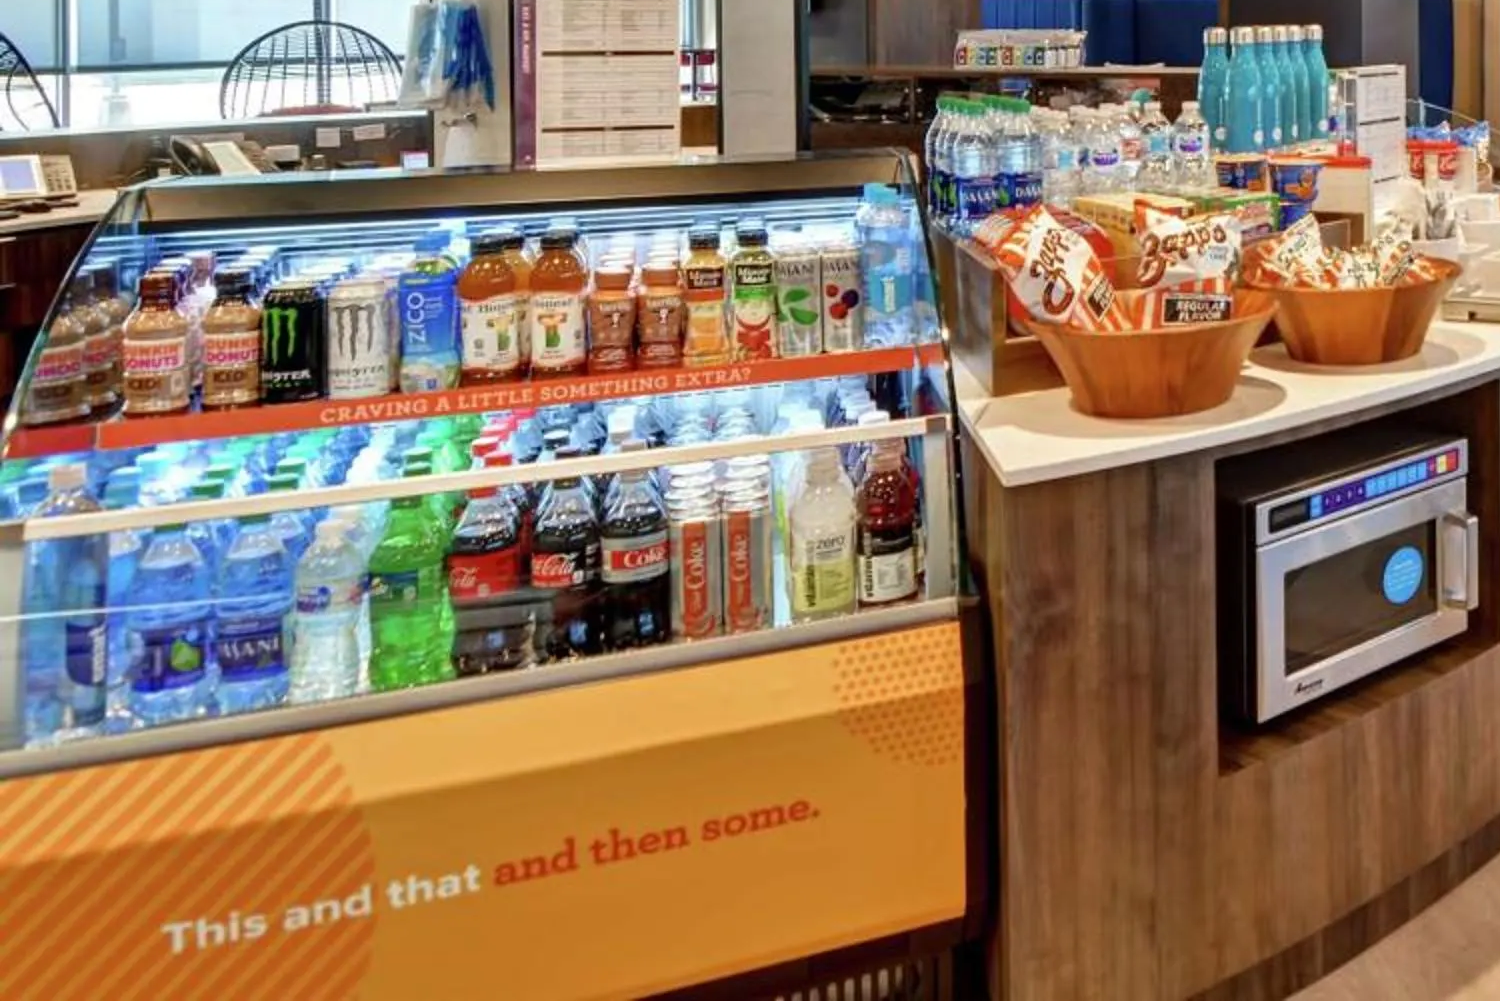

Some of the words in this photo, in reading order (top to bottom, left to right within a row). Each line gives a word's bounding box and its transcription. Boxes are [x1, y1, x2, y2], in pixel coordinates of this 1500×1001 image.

[407, 292, 427, 344] ZICO
[1176, 300, 1226, 312] REGULAR
[320, 400, 428, 424] CRAVING
[434, 396, 452, 412] A
[457, 387, 534, 410] LITTLE
[540, 376, 669, 401] SOMETHING
[675, 367, 753, 388] EXTRA?
[624, 548, 667, 568] Coke
[686, 540, 706, 590] Coke
[731, 534, 749, 582] Coke
[816, 535, 847, 549] zero
[160, 910, 268, 955] This
[283, 883, 373, 933] and
[385, 864, 481, 909] that
[493, 837, 580, 886] and
[588, 827, 690, 866] then
[700, 799, 821, 842] some.
